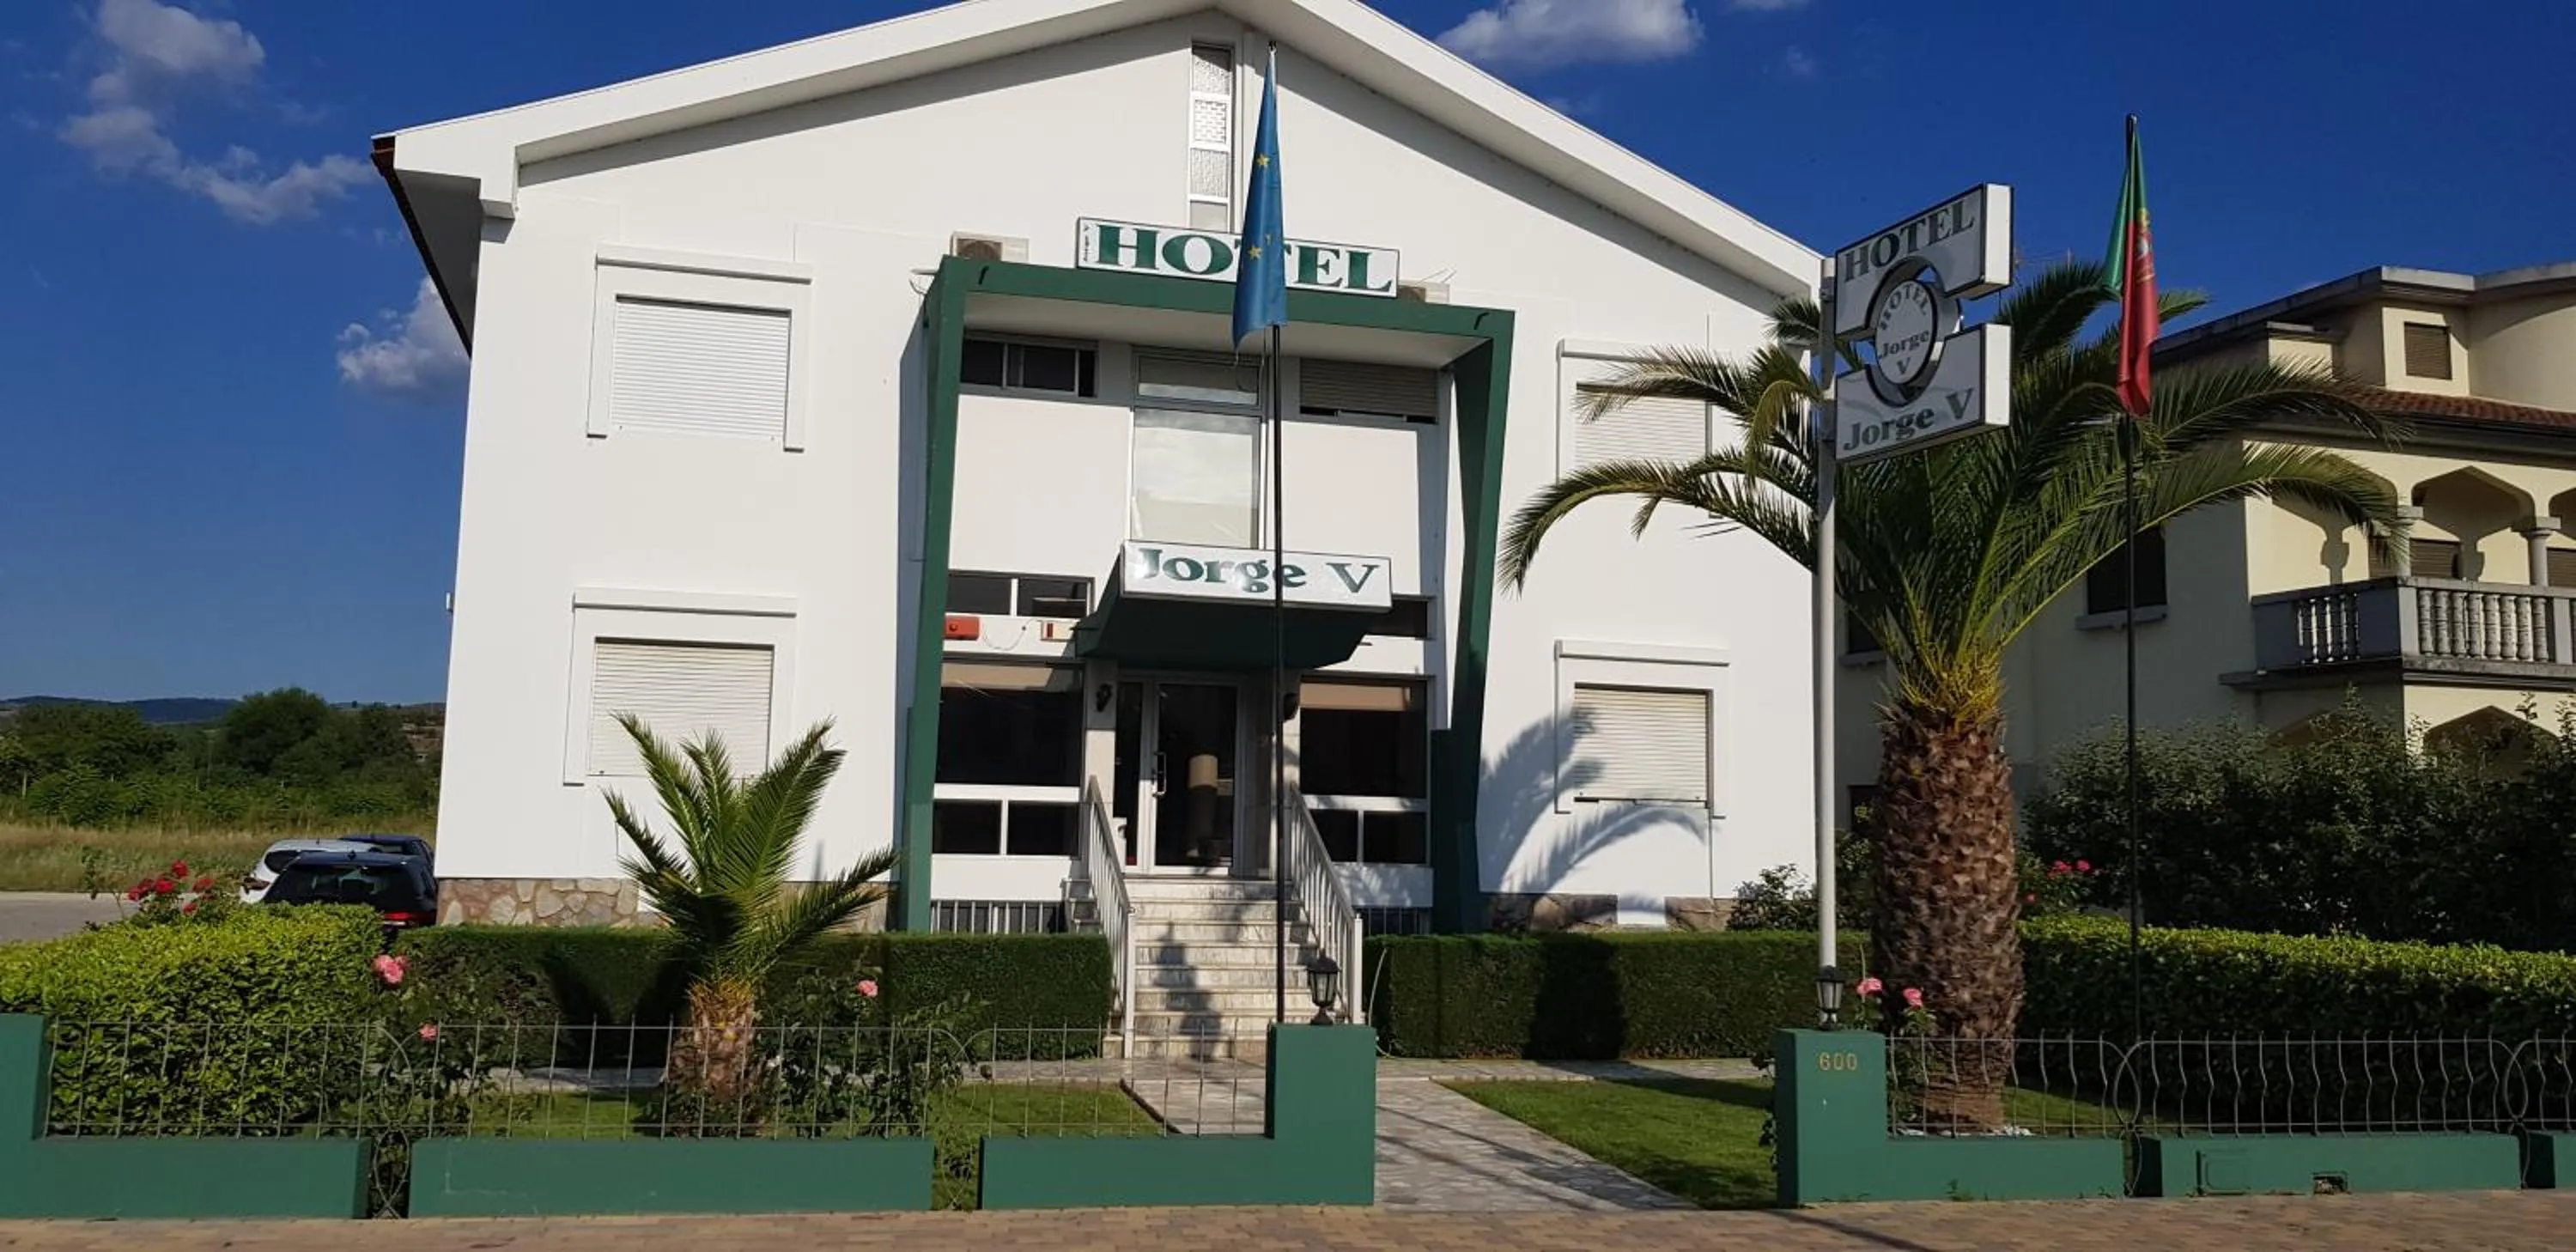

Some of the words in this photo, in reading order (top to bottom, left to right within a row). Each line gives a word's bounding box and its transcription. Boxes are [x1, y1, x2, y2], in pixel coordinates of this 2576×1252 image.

[1096, 224, 1392, 290] HOEL
[1844, 201, 1975, 283] HOTEL
[1880, 283, 1929, 331] HOTEL
[1877, 330, 1929, 360] Jorge
[1896, 356, 1911, 375] V
[1842, 406, 1935, 452] Jorge
[1945, 387, 1974, 420] V
[1137, 547, 1307, 593] Jorge
[1325, 562, 1381, 593] V
[1819, 1051, 1858, 1072] 600
